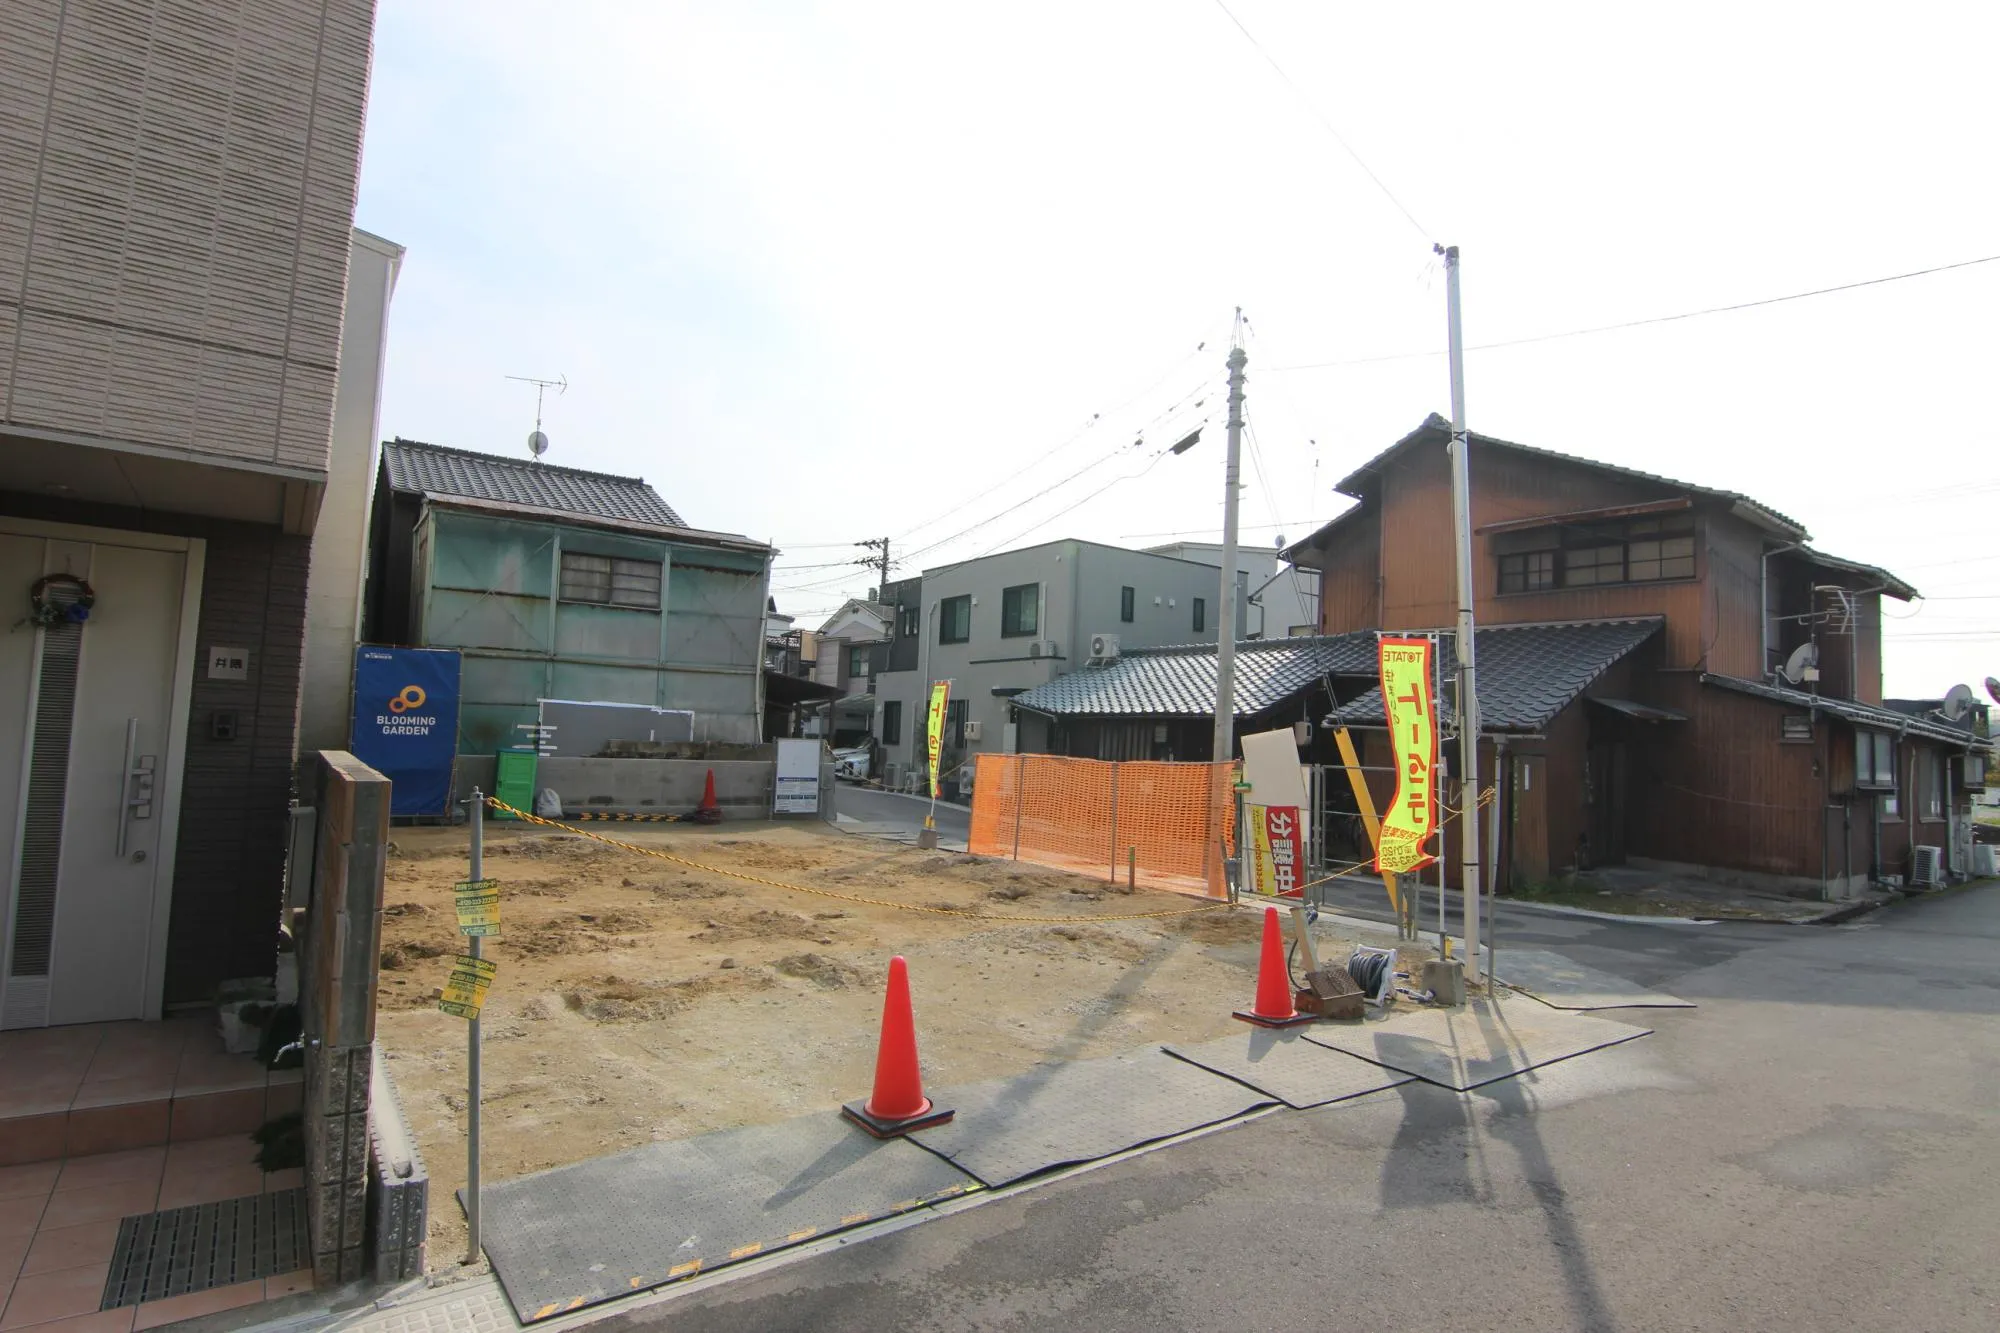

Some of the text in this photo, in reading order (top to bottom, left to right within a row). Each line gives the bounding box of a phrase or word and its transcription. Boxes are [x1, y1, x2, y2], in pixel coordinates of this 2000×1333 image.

[376, 715, 436, 726] BLOOMING
[382, 726, 429, 736] GARDEN
[1270, 812, 1296, 890] 分譲中
